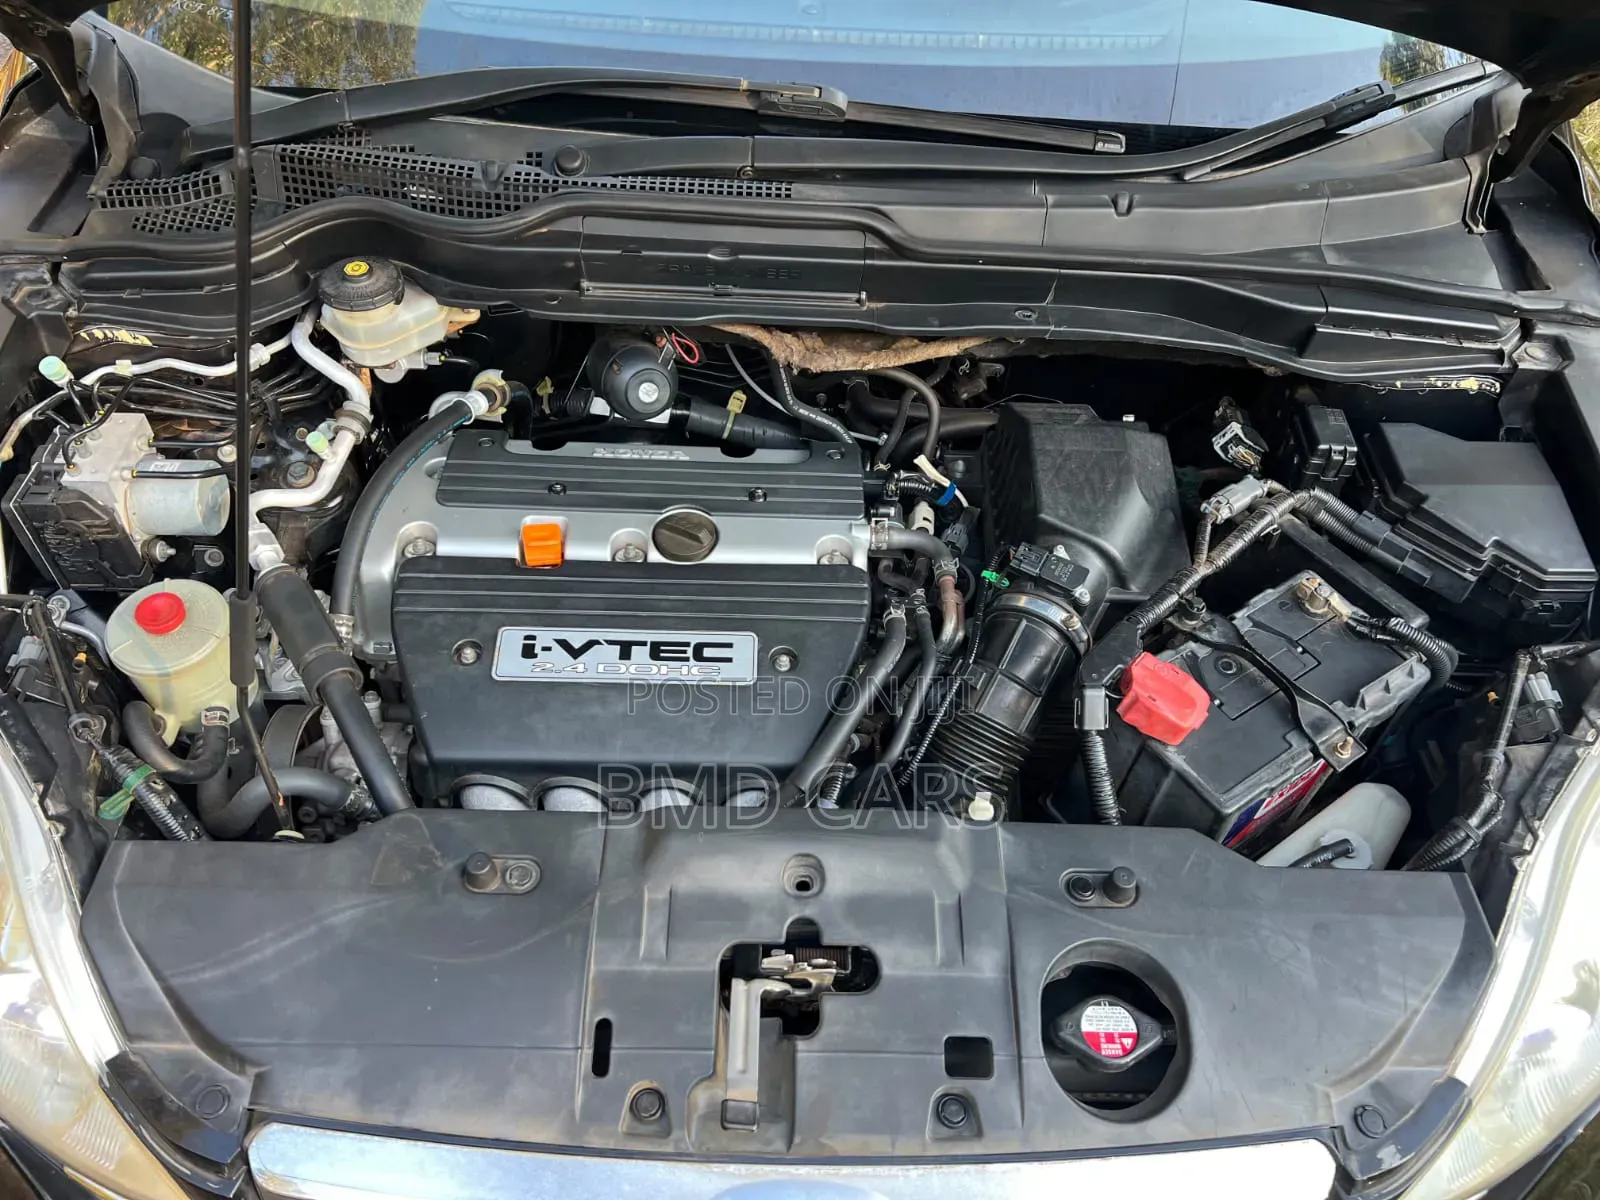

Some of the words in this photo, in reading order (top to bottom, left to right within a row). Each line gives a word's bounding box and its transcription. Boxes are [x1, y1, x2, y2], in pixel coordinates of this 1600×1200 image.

[592, 447, 690, 461] HONDA
[521, 634, 734, 663] i-VTEC
[530, 662, 588, 674] 2.4
[596, 663, 721, 676] DOHC
